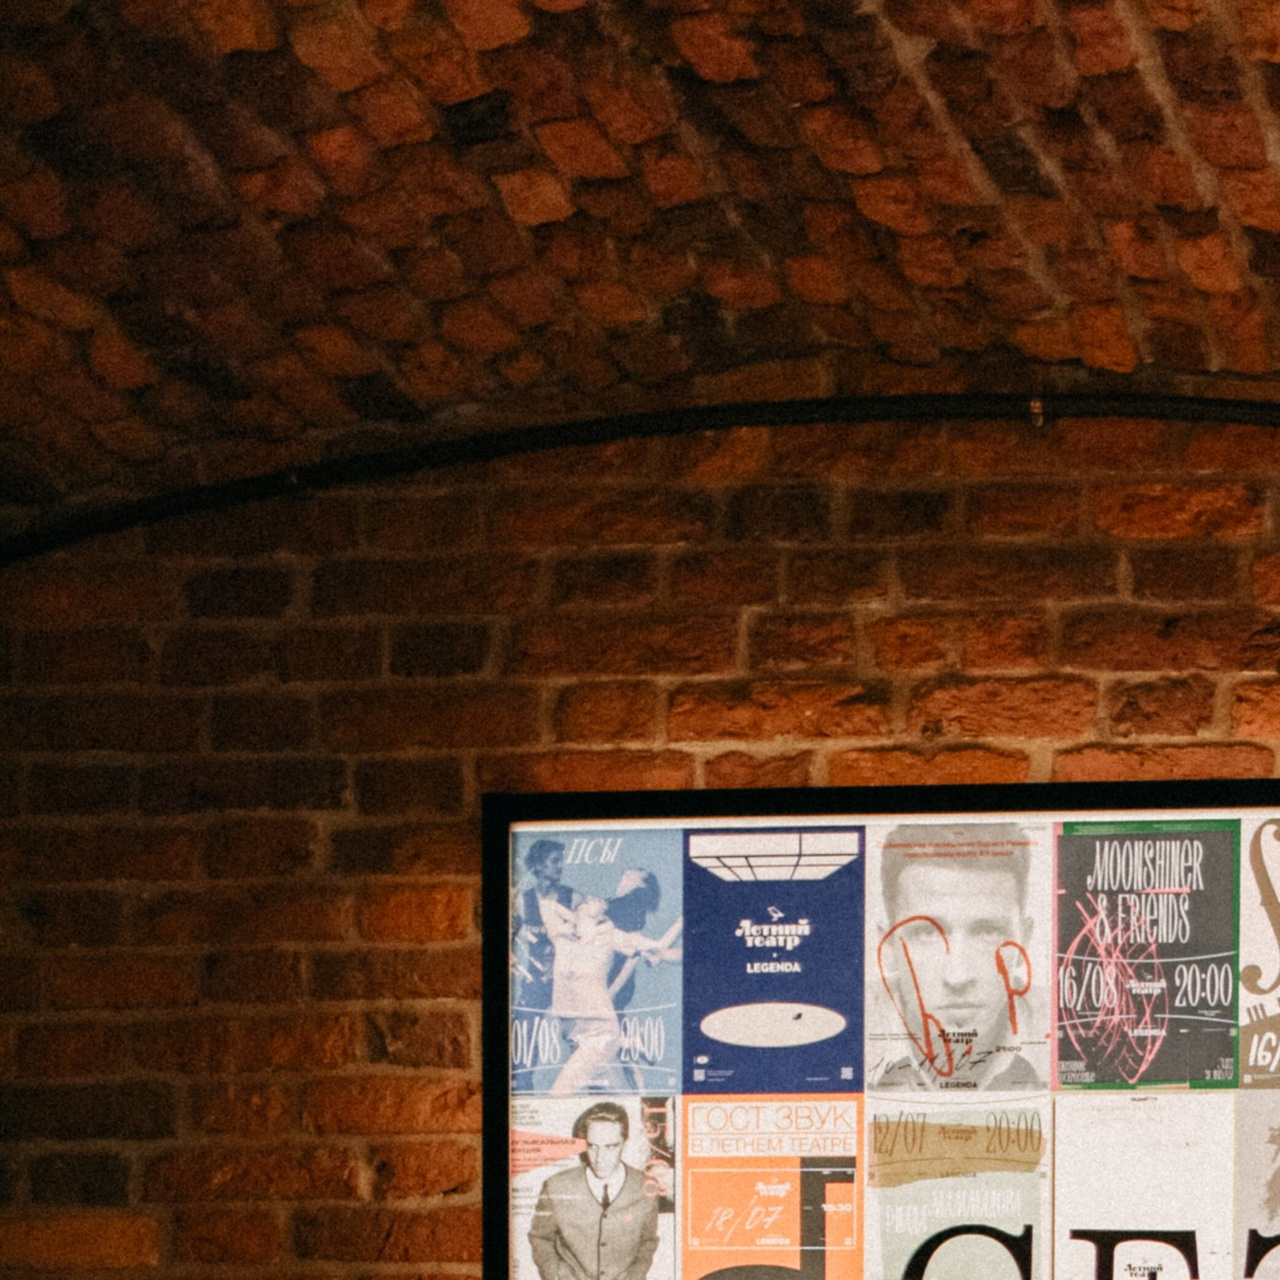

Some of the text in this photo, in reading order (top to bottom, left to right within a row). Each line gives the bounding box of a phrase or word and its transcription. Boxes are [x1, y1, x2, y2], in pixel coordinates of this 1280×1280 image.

[735, 918, 811, 937] Летний
[745, 935, 800, 950] театр
[746, 962, 801, 973] LEGENDA
[1059, 962, 1233, 1011] 16/08 20:00
[692, 1105, 851, 1132] ГОСТ ЗВУК
[873, 1110, 1042, 1156] 12/07 20:00
[709, 1137, 850, 1153] ЛЕТНЕМ ТЕАТРЕ
[705, 1194, 784, 1243] 18/07
